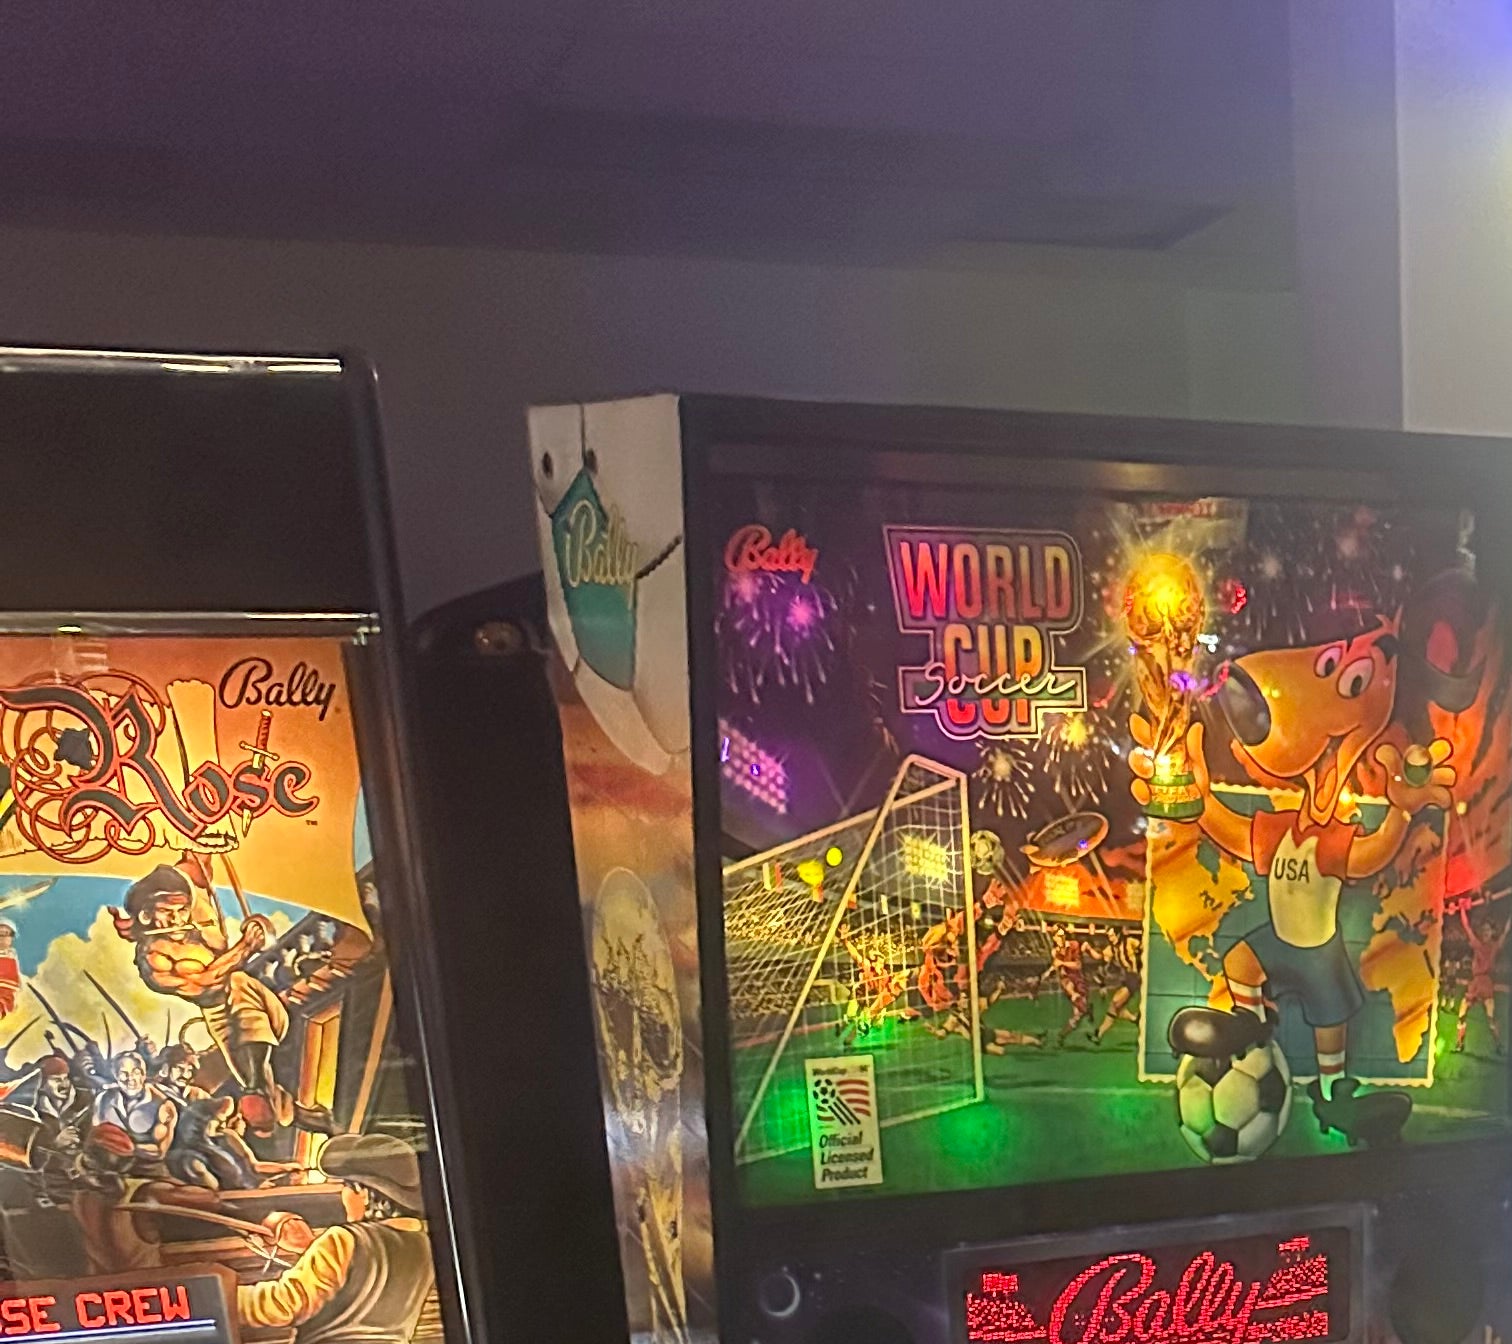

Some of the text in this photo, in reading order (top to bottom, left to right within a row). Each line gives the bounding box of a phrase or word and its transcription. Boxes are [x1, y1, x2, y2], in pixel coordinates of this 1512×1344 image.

[565, 500, 638, 611] Bally
[725, 524, 818, 584] Bally
[900, 541, 1072, 619] WORLD
[219, 657, 336, 721] Bally
[914, 663, 1077, 706] Soccer
[943, 624, 1044, 724] CUP
[0, 683, 320, 840] Rose
[1274, 857, 1311, 883] USA
[0, 1285, 192, 1336] SE CREW
